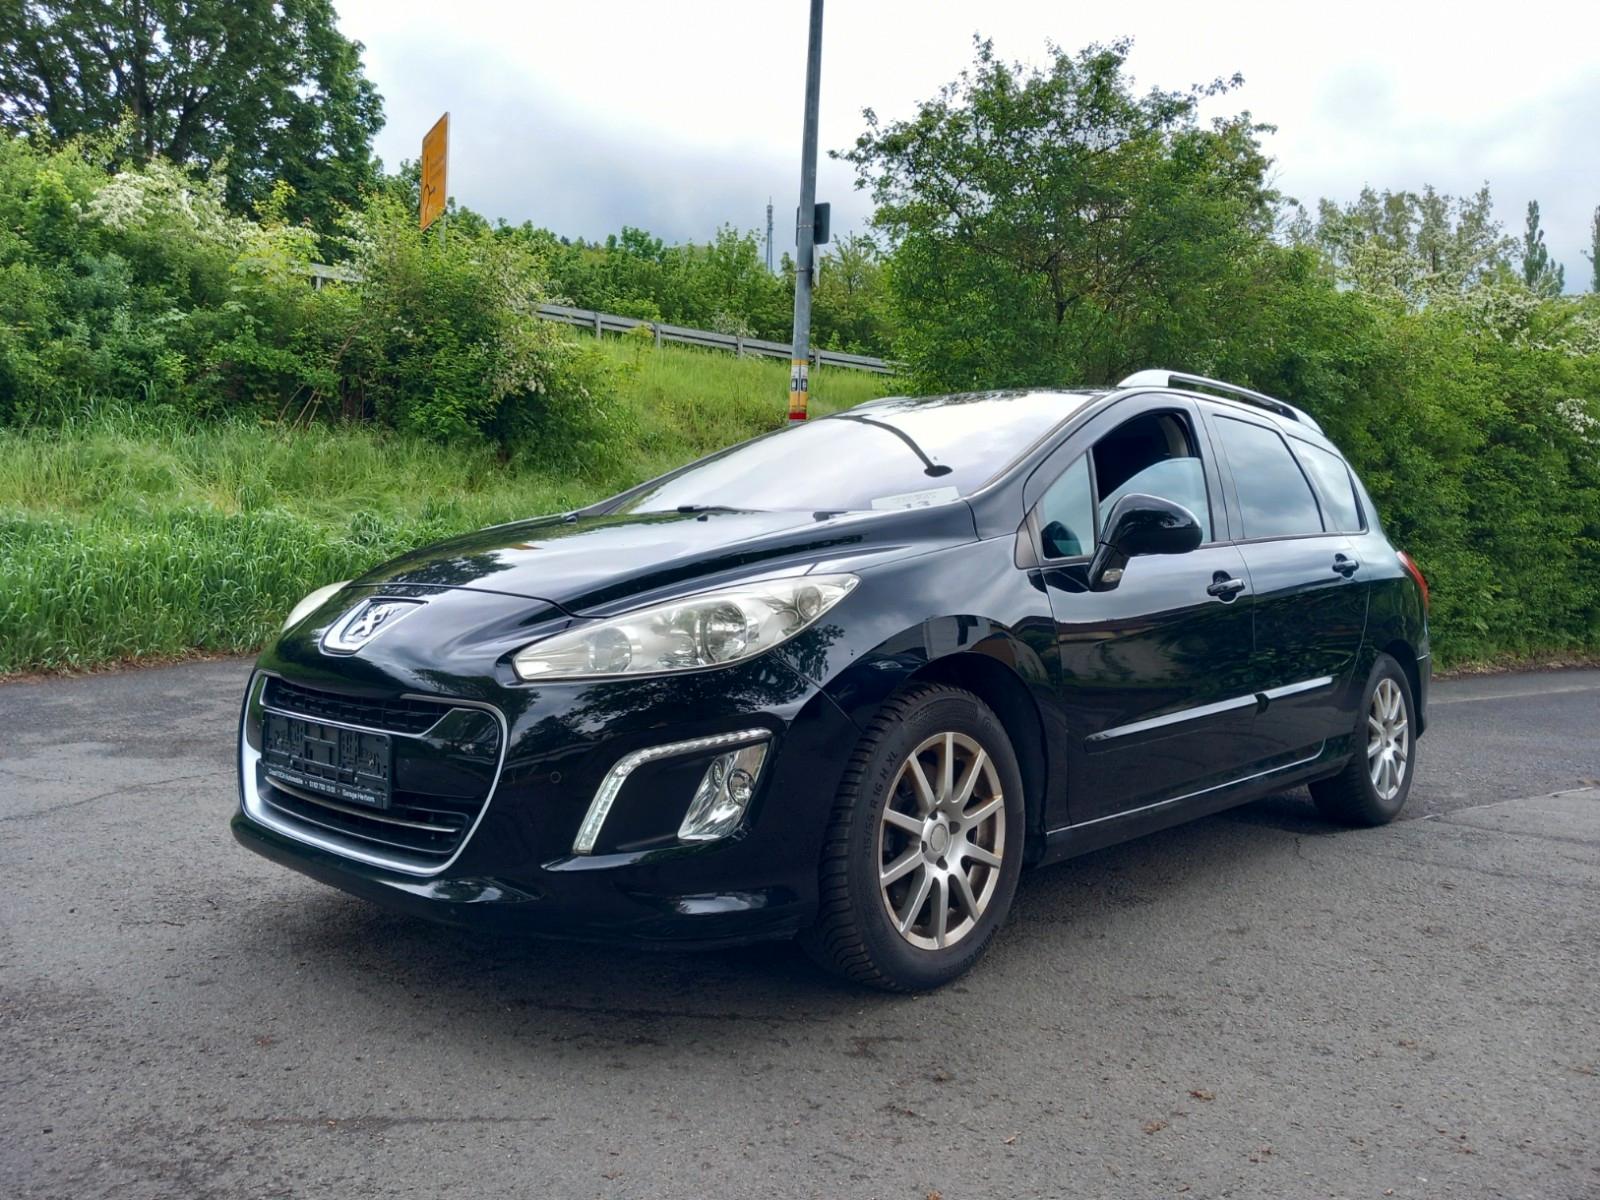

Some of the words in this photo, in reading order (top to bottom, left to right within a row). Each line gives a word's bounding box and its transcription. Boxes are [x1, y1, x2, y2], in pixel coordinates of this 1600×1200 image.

[886, 751, 899, 767] XL
[872, 782, 884, 796] 16
[869, 799, 879, 809] R
